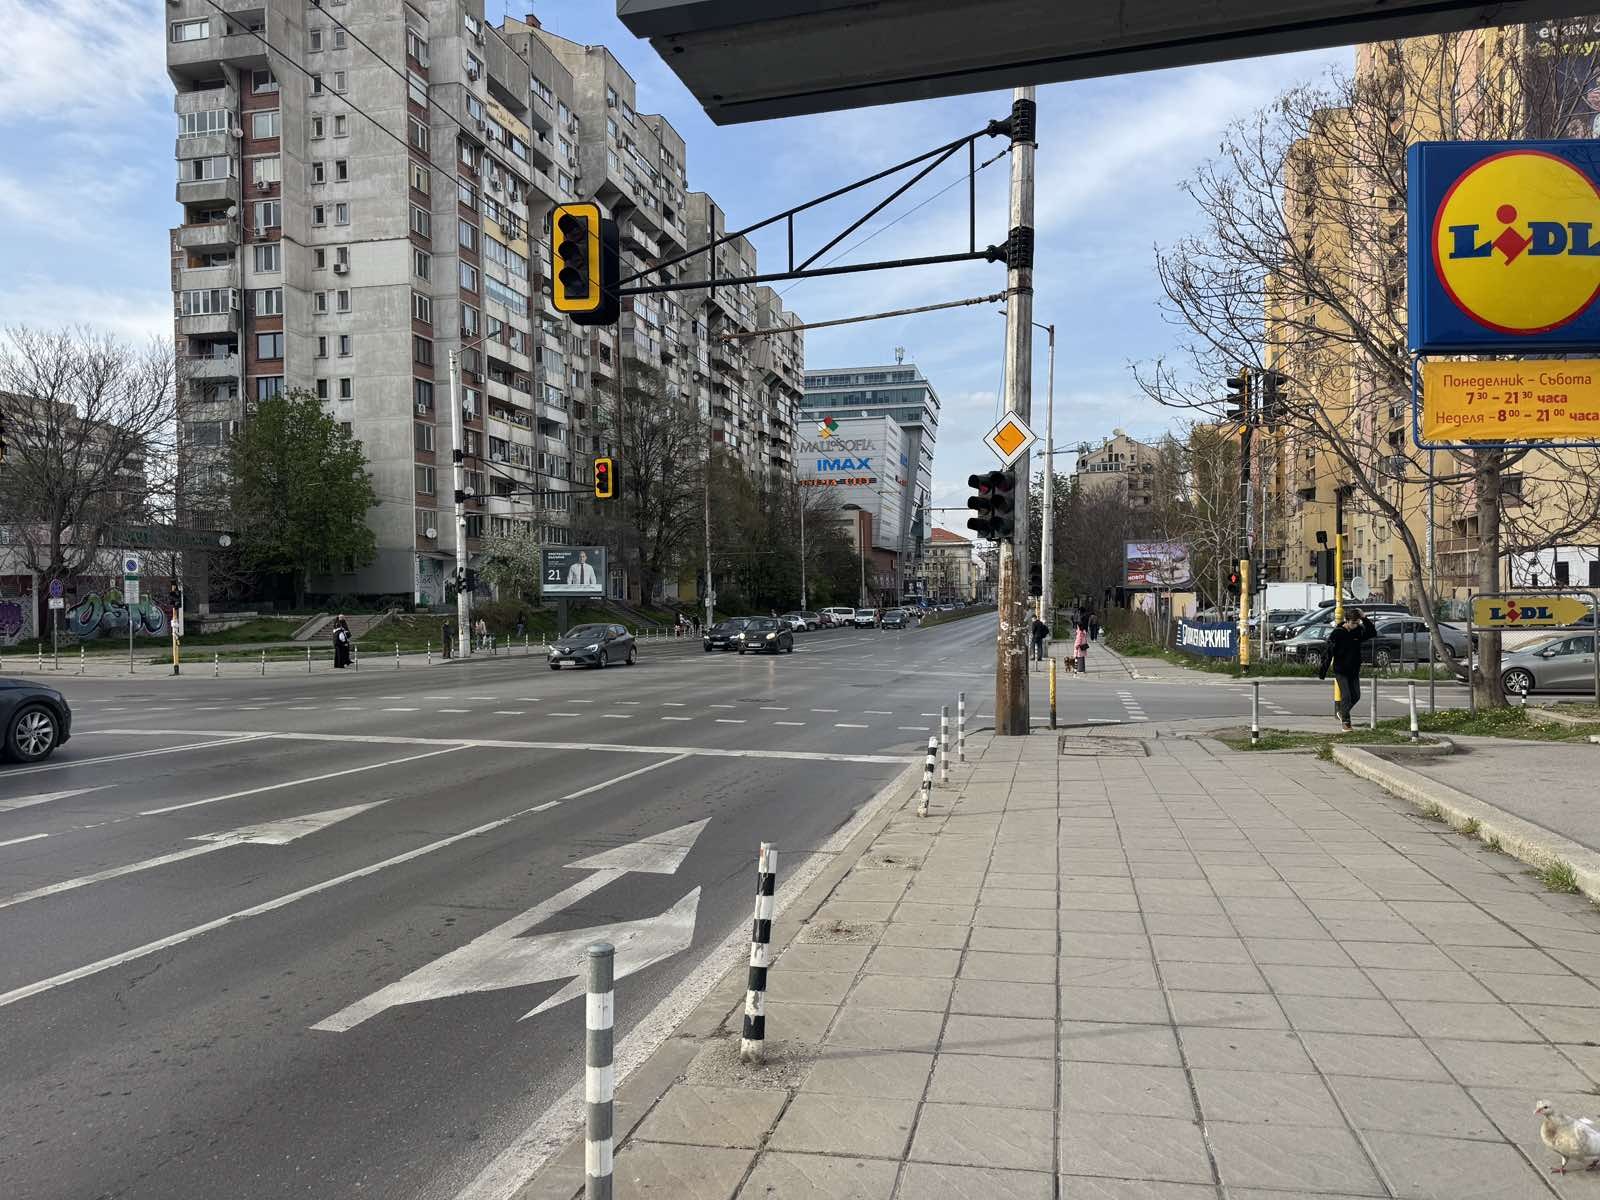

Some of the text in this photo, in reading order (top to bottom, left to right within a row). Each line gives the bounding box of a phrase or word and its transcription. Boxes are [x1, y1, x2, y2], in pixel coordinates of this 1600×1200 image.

[1443, 374, 1524, 390] Понеделник
[1539, 372, 1592, 386] Събота
[1537, 393, 1568, 404] часа
[1436, 411, 1484, 427] Неделя
[1569, 411, 1600, 422] часа
[800, 440, 833, 453] MALL
[840, 438, 876, 452] SOFIA
[816, 457, 871, 472] IMAX
[548, 569, 561, 581] 21
